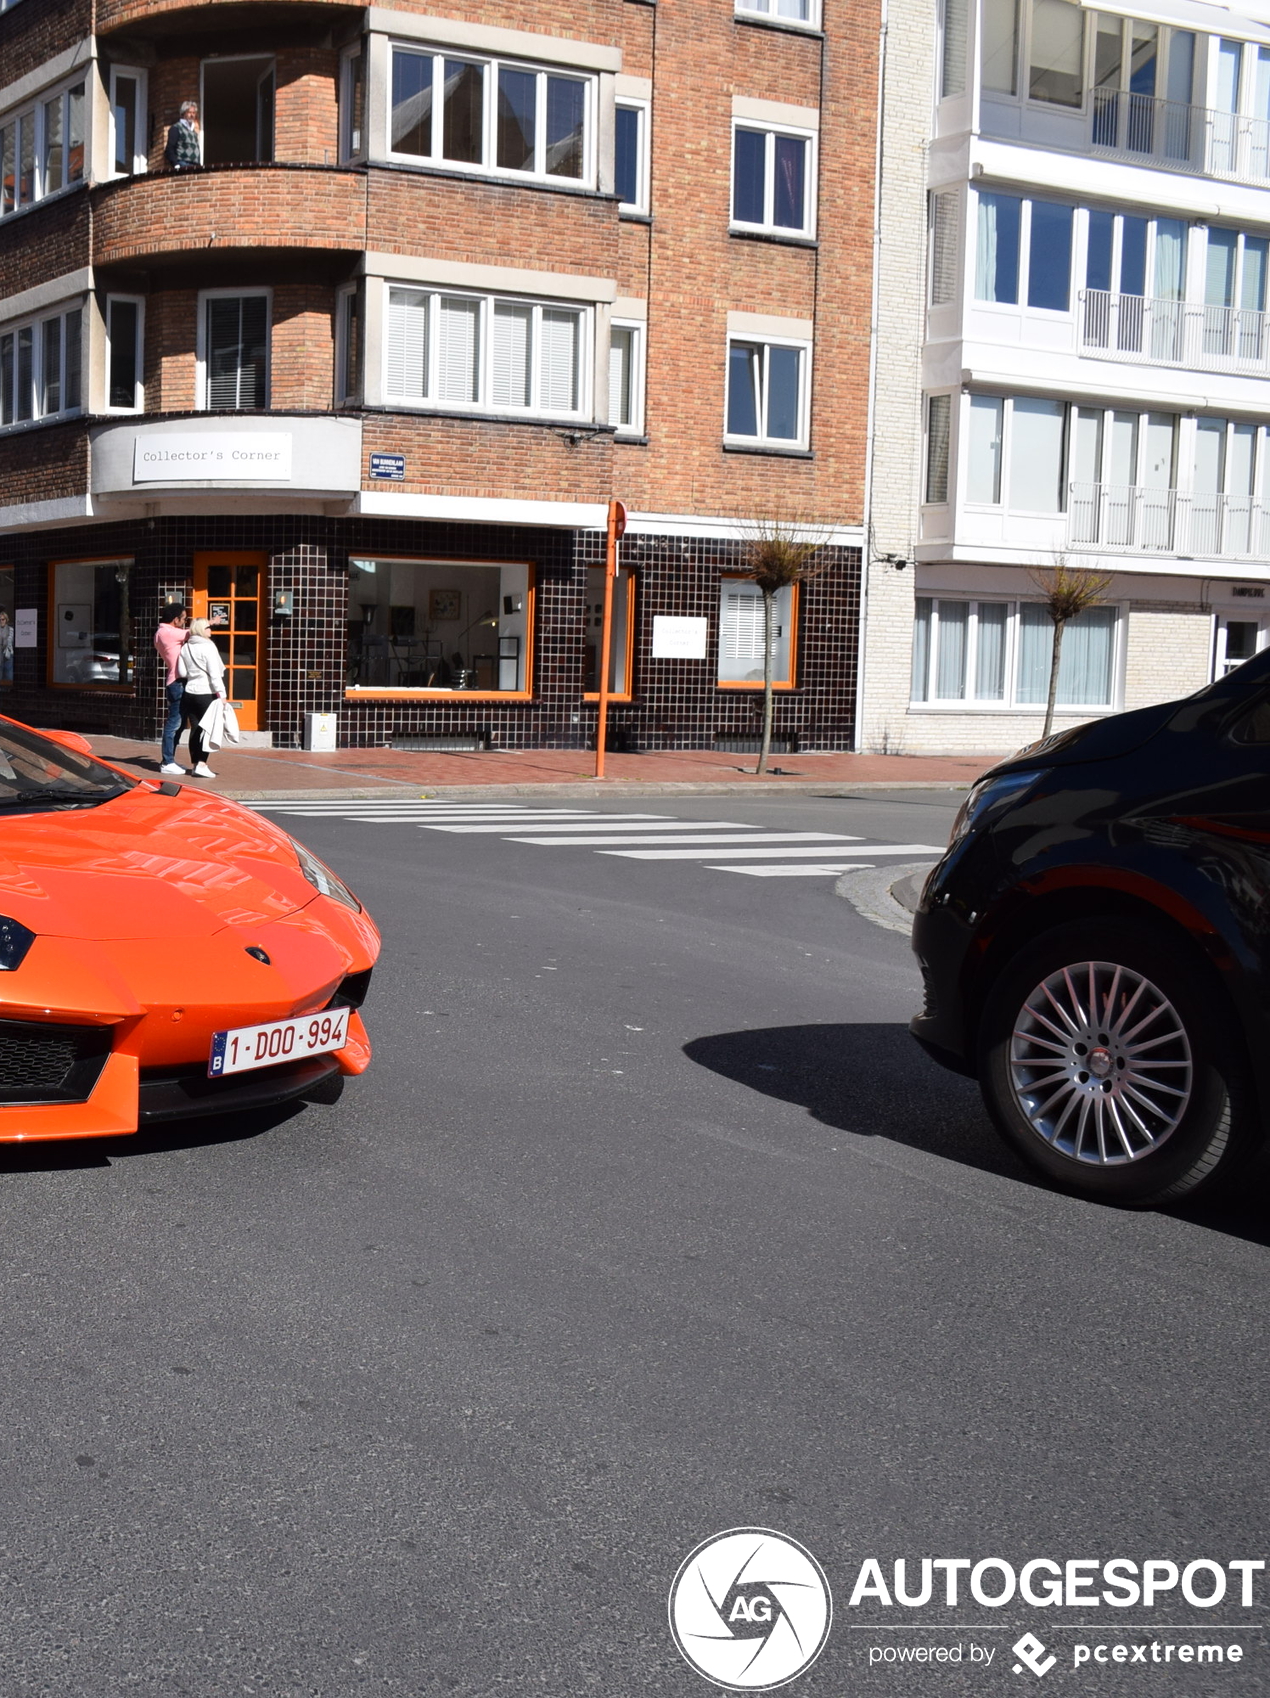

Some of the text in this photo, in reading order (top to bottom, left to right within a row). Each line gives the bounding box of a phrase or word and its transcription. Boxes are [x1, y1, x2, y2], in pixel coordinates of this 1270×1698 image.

[143, 450, 281, 462] Collector's Corner
[212, 1055, 222, 1071] B
